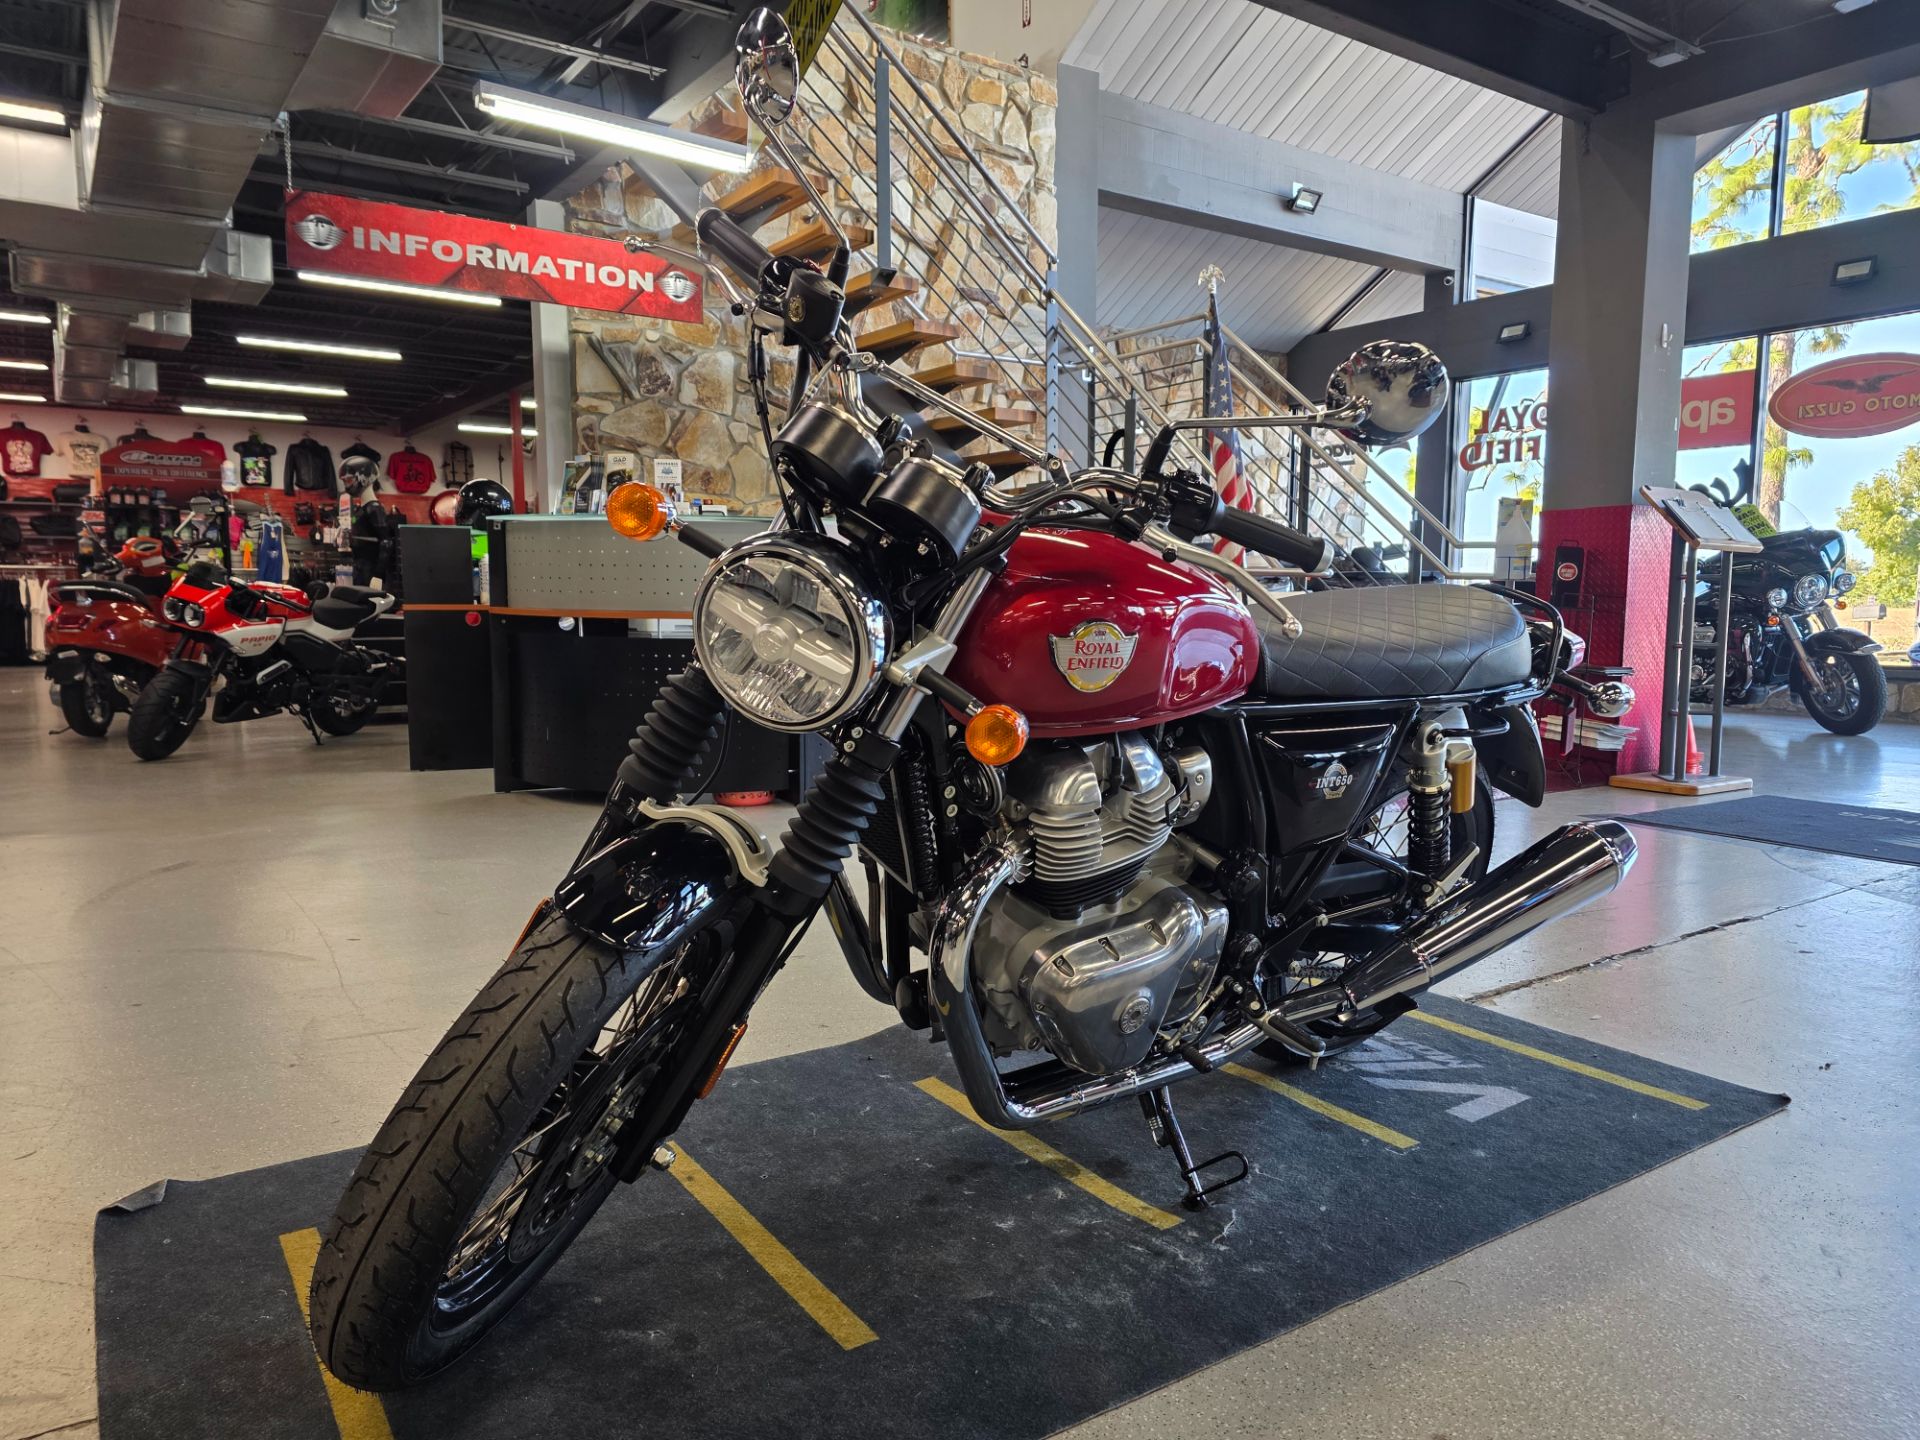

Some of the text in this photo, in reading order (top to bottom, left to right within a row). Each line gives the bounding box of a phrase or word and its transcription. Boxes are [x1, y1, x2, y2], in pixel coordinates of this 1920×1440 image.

[352, 226, 655, 293] INFORMATION
[1074, 640, 1121, 656] ROYAL
[1067, 656, 1124, 672] ENFIELD
[1315, 774, 1354, 789] INT650
